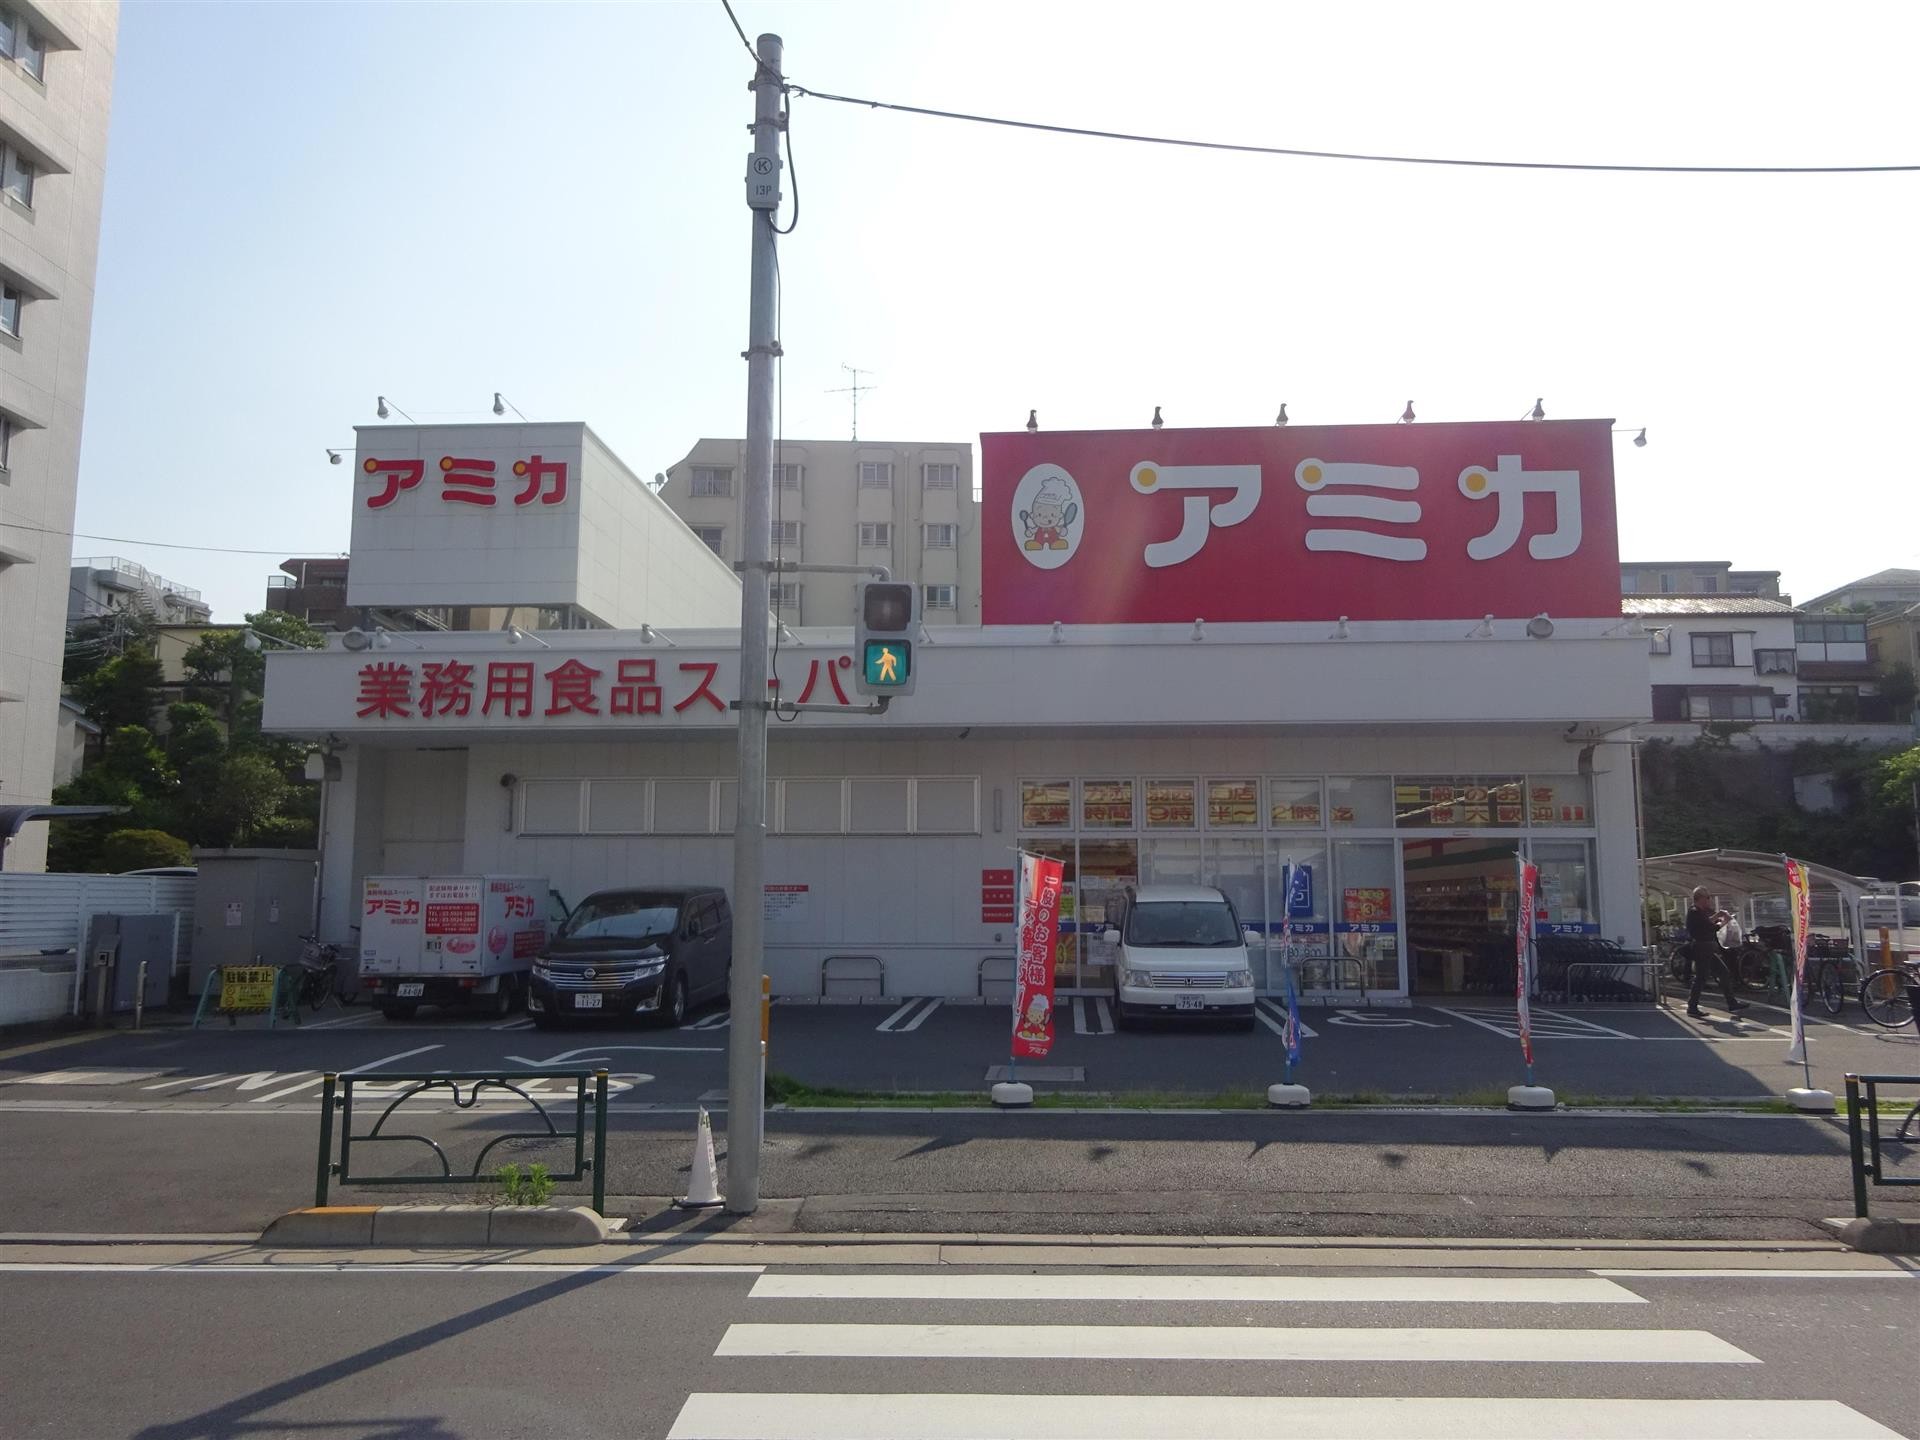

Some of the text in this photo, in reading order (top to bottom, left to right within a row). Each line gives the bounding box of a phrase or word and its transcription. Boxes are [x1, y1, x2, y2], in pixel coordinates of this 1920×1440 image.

[362, 454, 569, 508] アミカ
[1129, 454, 1583, 568] アミカ
[366, 898, 420, 916] アミカ
[1350, 924, 1380, 932] アミカ
[1551, 924, 1583, 933] アミカ
